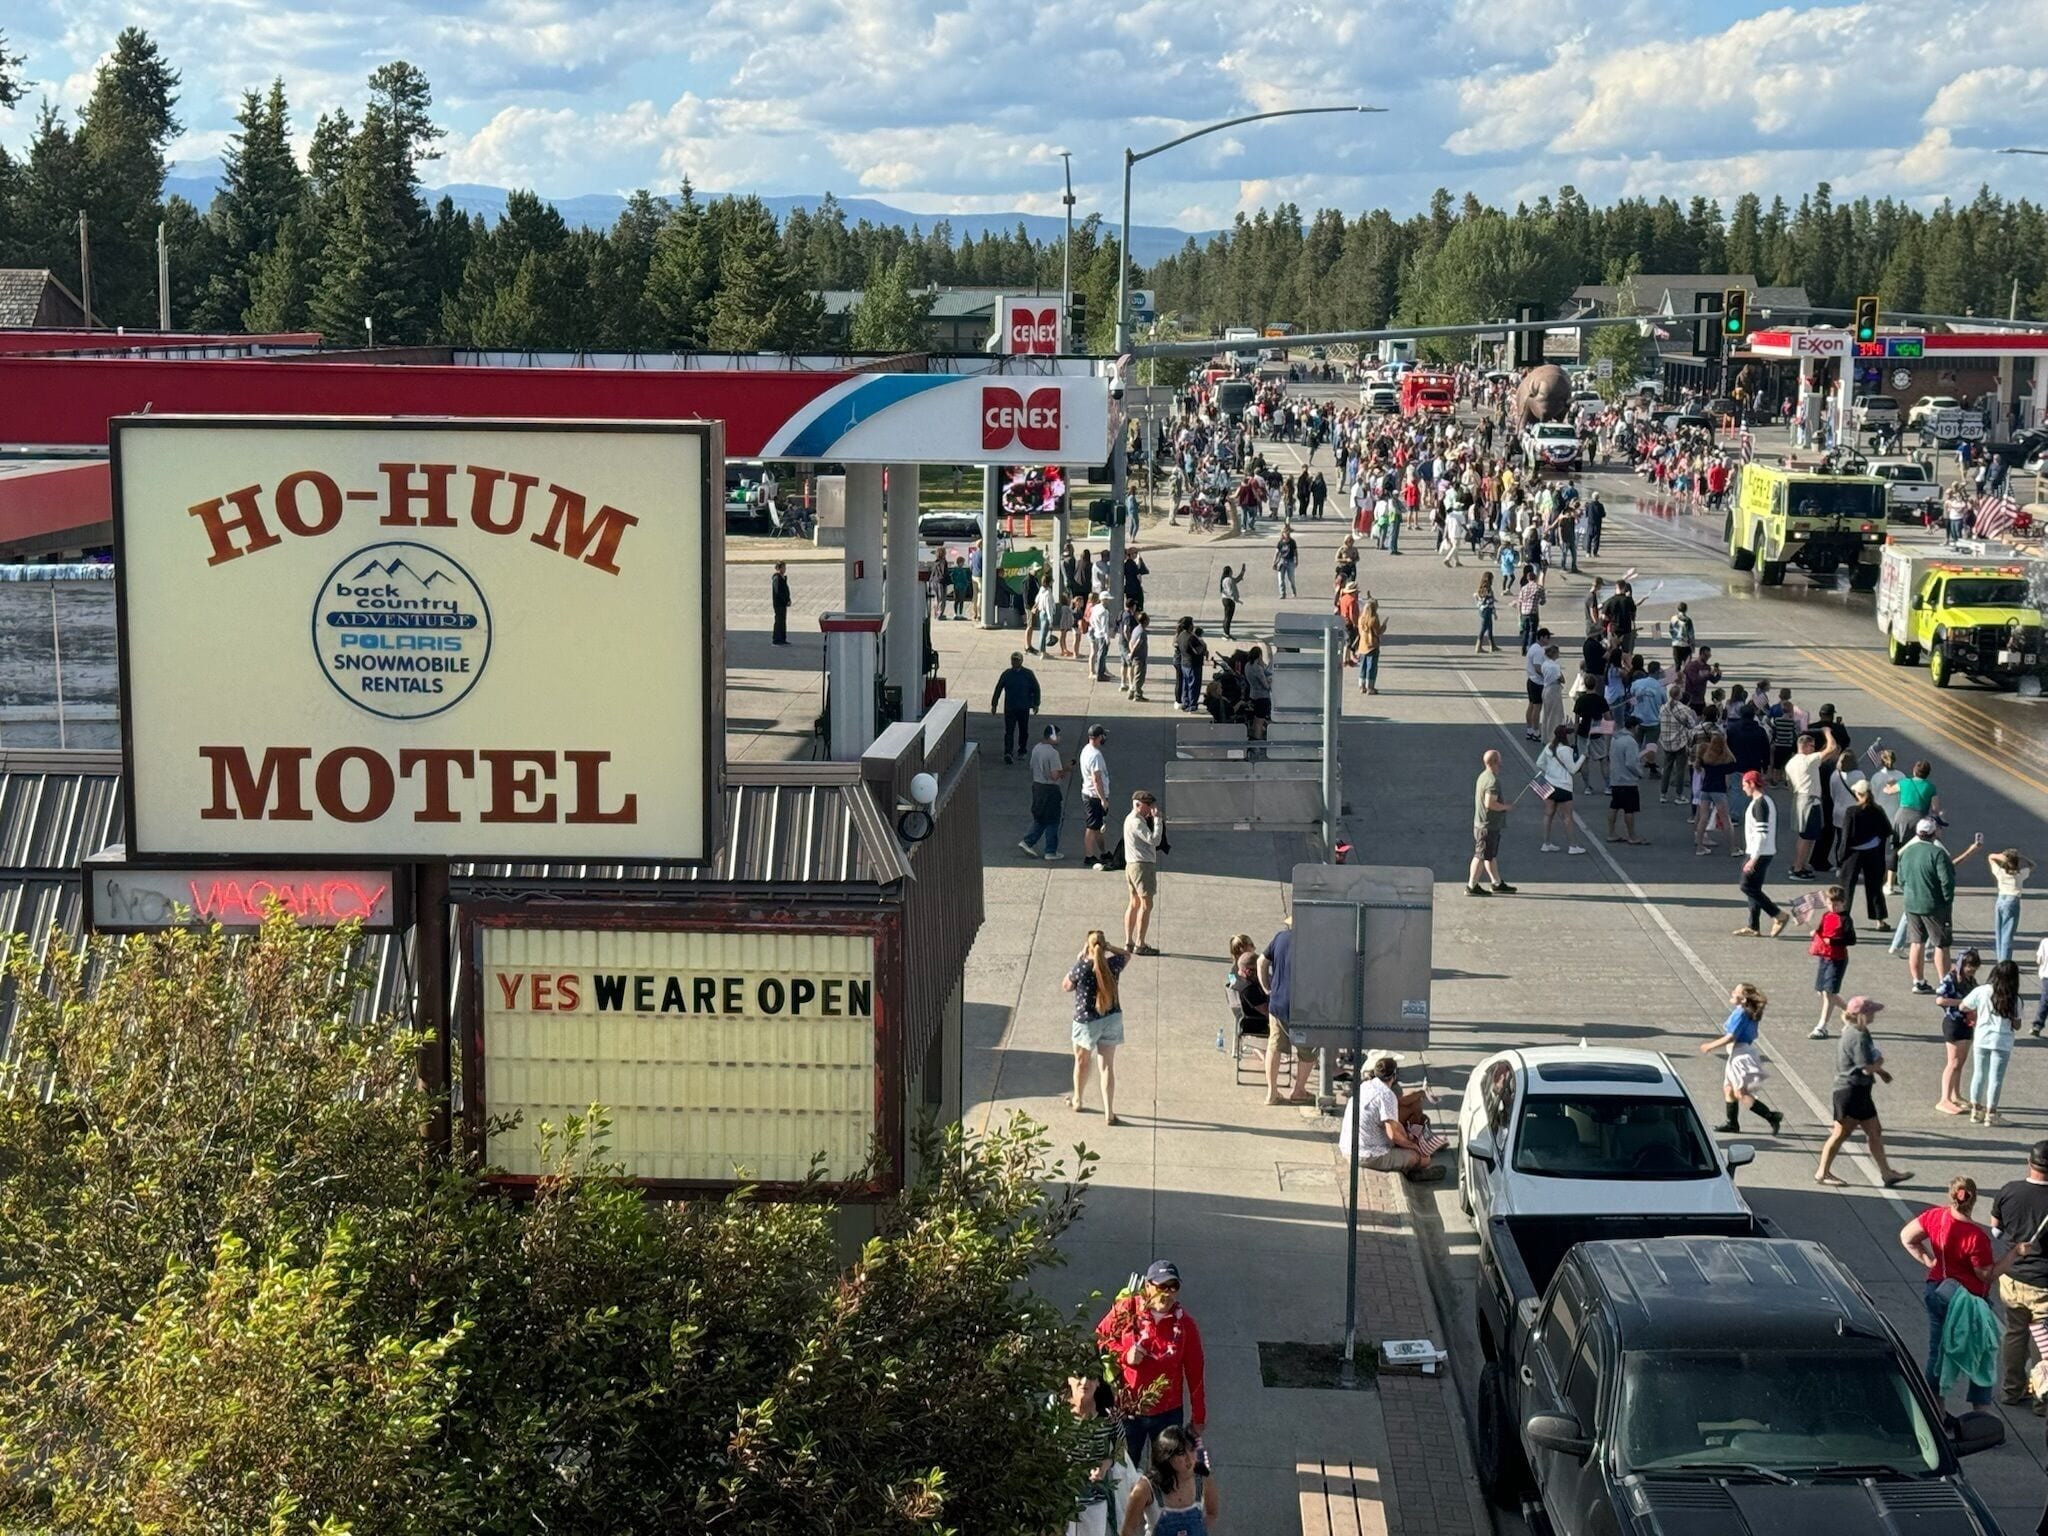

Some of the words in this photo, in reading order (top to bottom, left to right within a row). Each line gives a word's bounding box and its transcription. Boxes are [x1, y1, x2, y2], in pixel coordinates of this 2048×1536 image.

[1013, 325, 1055, 342] CENEX
[1798, 337, 1844, 354] Exxon
[985, 407, 1058, 428] CENEX
[1940, 425, 1956, 436] 191
[1962, 425, 1981, 436] 287
[188, 463, 639, 576] HO-HUM
[337, 583, 400, 597] back
[356, 598, 458, 613] country
[335, 614, 470, 628] ADVENTURE
[341, 633, 462, 651] POLARIS
[334, 654, 470, 673] SNOWMOBILE
[361, 677, 443, 693] RENTALS
[200, 746, 638, 824] MOTEL
[191, 880, 386, 917] VACANCY
[496, 973, 581, 1012] YES
[757, 978, 871, 1017] OPEN
